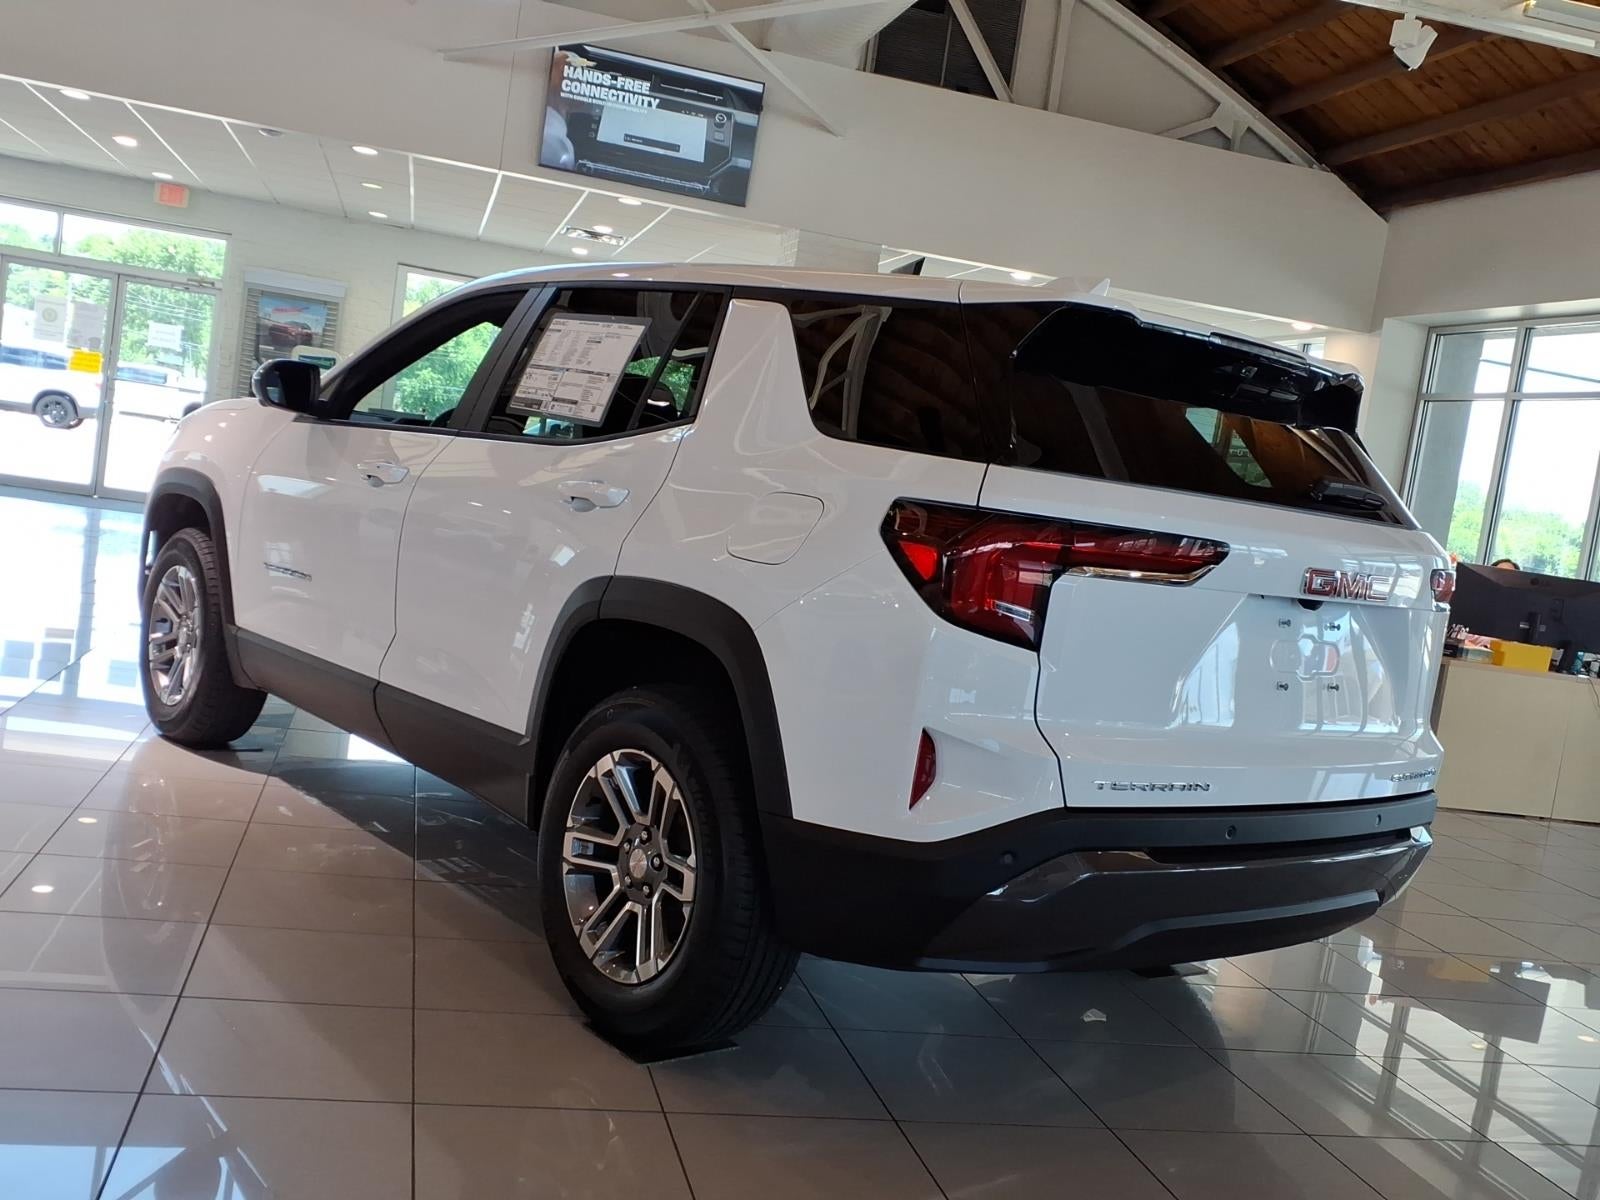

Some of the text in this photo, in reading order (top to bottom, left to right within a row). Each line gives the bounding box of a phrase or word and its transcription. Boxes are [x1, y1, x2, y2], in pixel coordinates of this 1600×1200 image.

[561, 79, 660, 110] CONNECTIVITY
[563, 65, 651, 94] HANDS-FREE
[1303, 567, 1392, 602] GMC
[1093, 780, 1211, 792] TERRAIN
